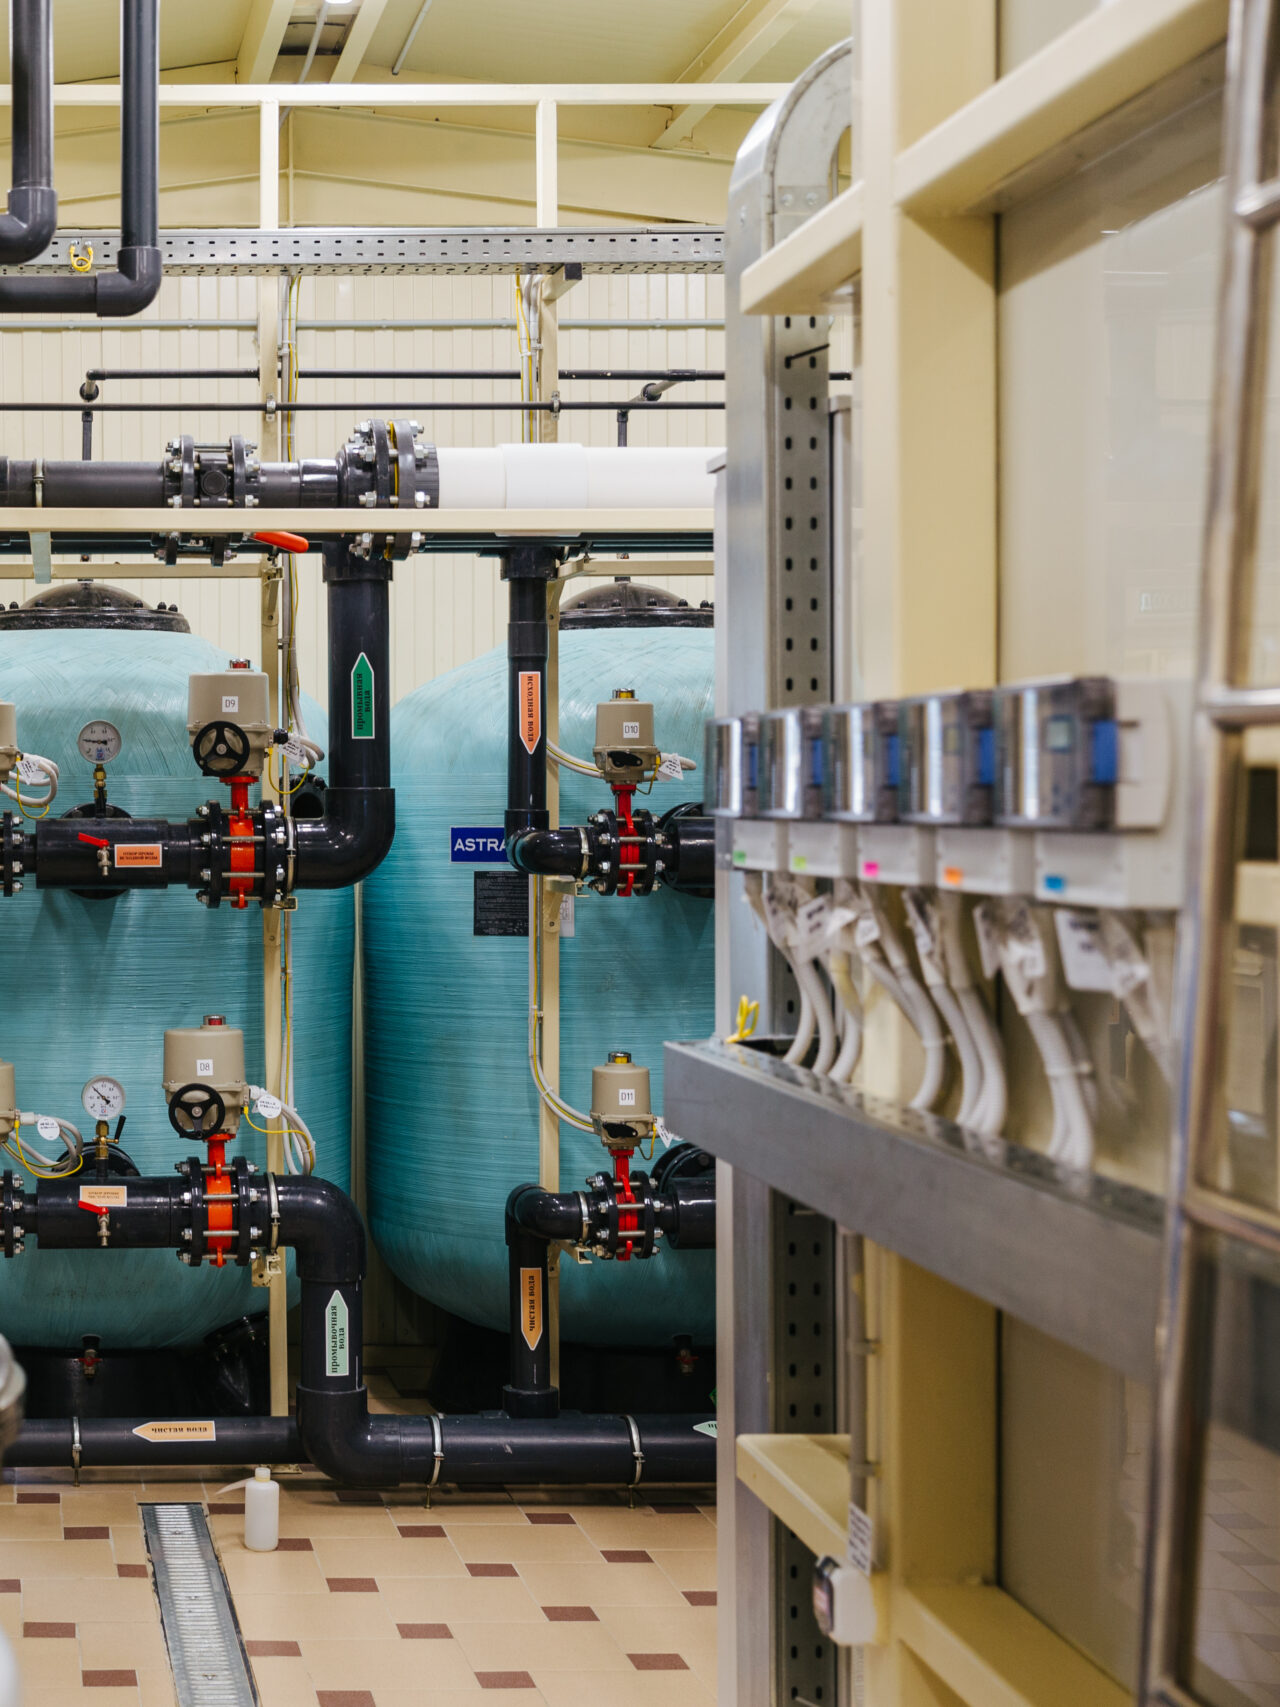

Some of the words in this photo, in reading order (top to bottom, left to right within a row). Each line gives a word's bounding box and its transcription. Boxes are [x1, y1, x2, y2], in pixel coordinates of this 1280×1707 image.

[225, 699, 236, 708] D9
[624, 725, 638, 734] D10
[199, 1062, 210, 1071] D8
[620, 1092, 634, 1101] D11
[528, 1299, 536, 1332] чистая
[330, 1305, 340, 1373] промывочная
